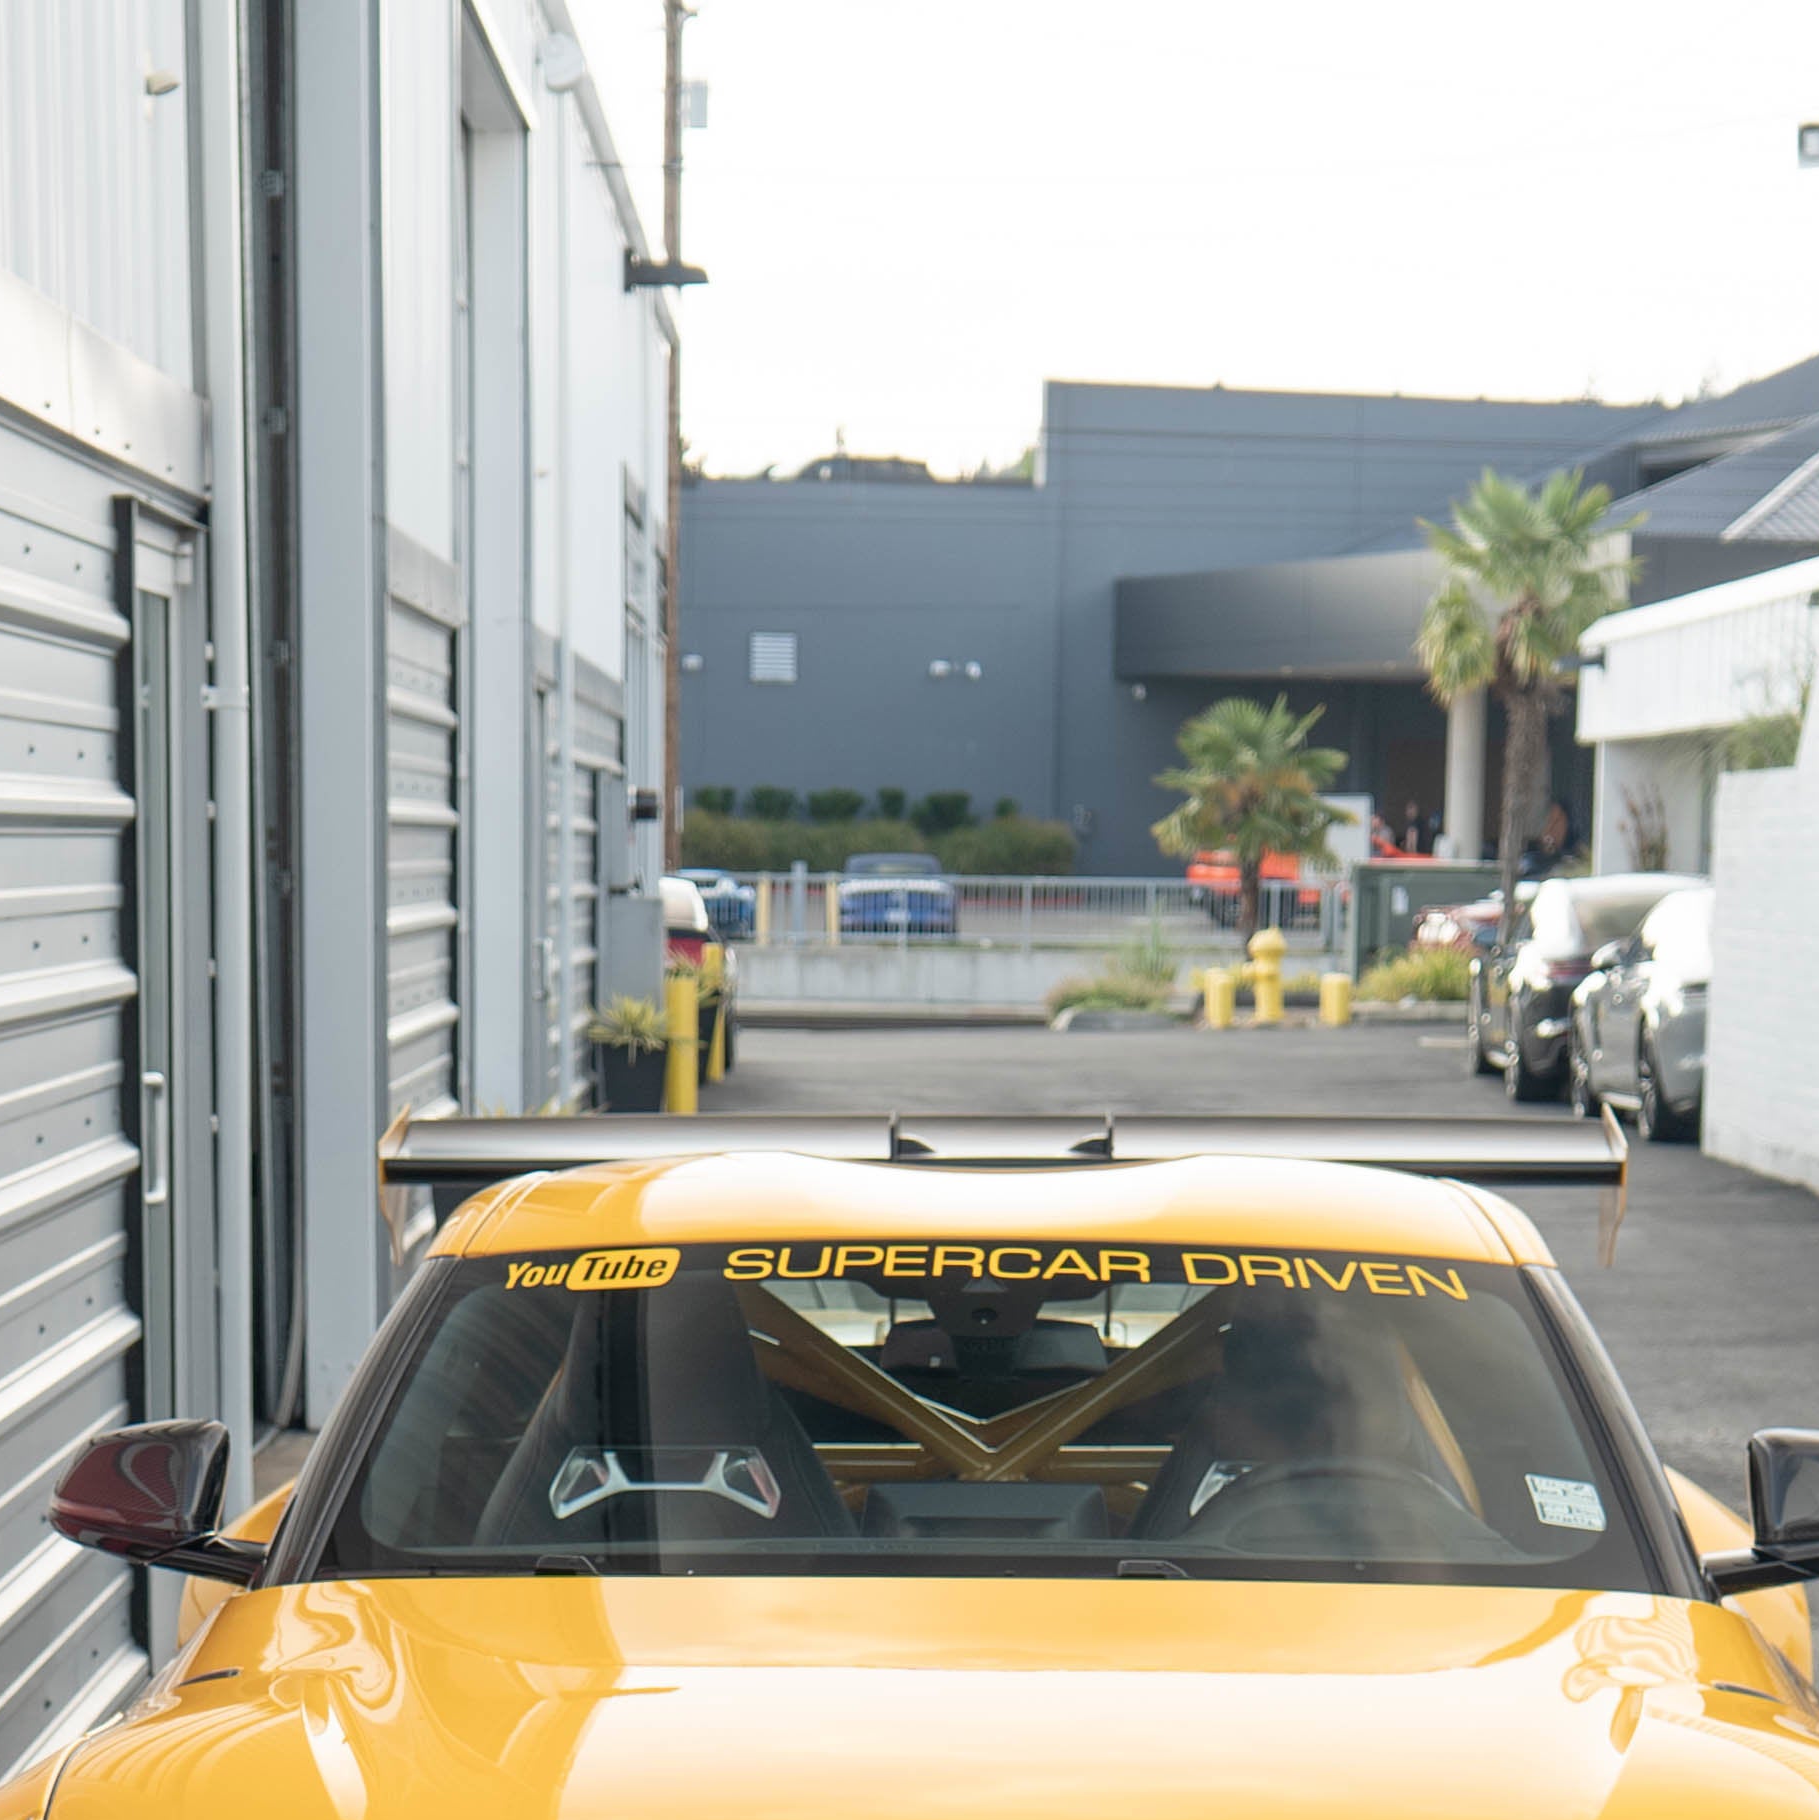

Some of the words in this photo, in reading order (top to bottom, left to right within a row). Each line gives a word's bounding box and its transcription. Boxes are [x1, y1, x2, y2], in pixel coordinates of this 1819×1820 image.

[505, 1248, 680, 1291] YouTube
[723, 1245, 1151, 1283] SUPERCAR
[1181, 1252, 1469, 1301] DRIVEN
